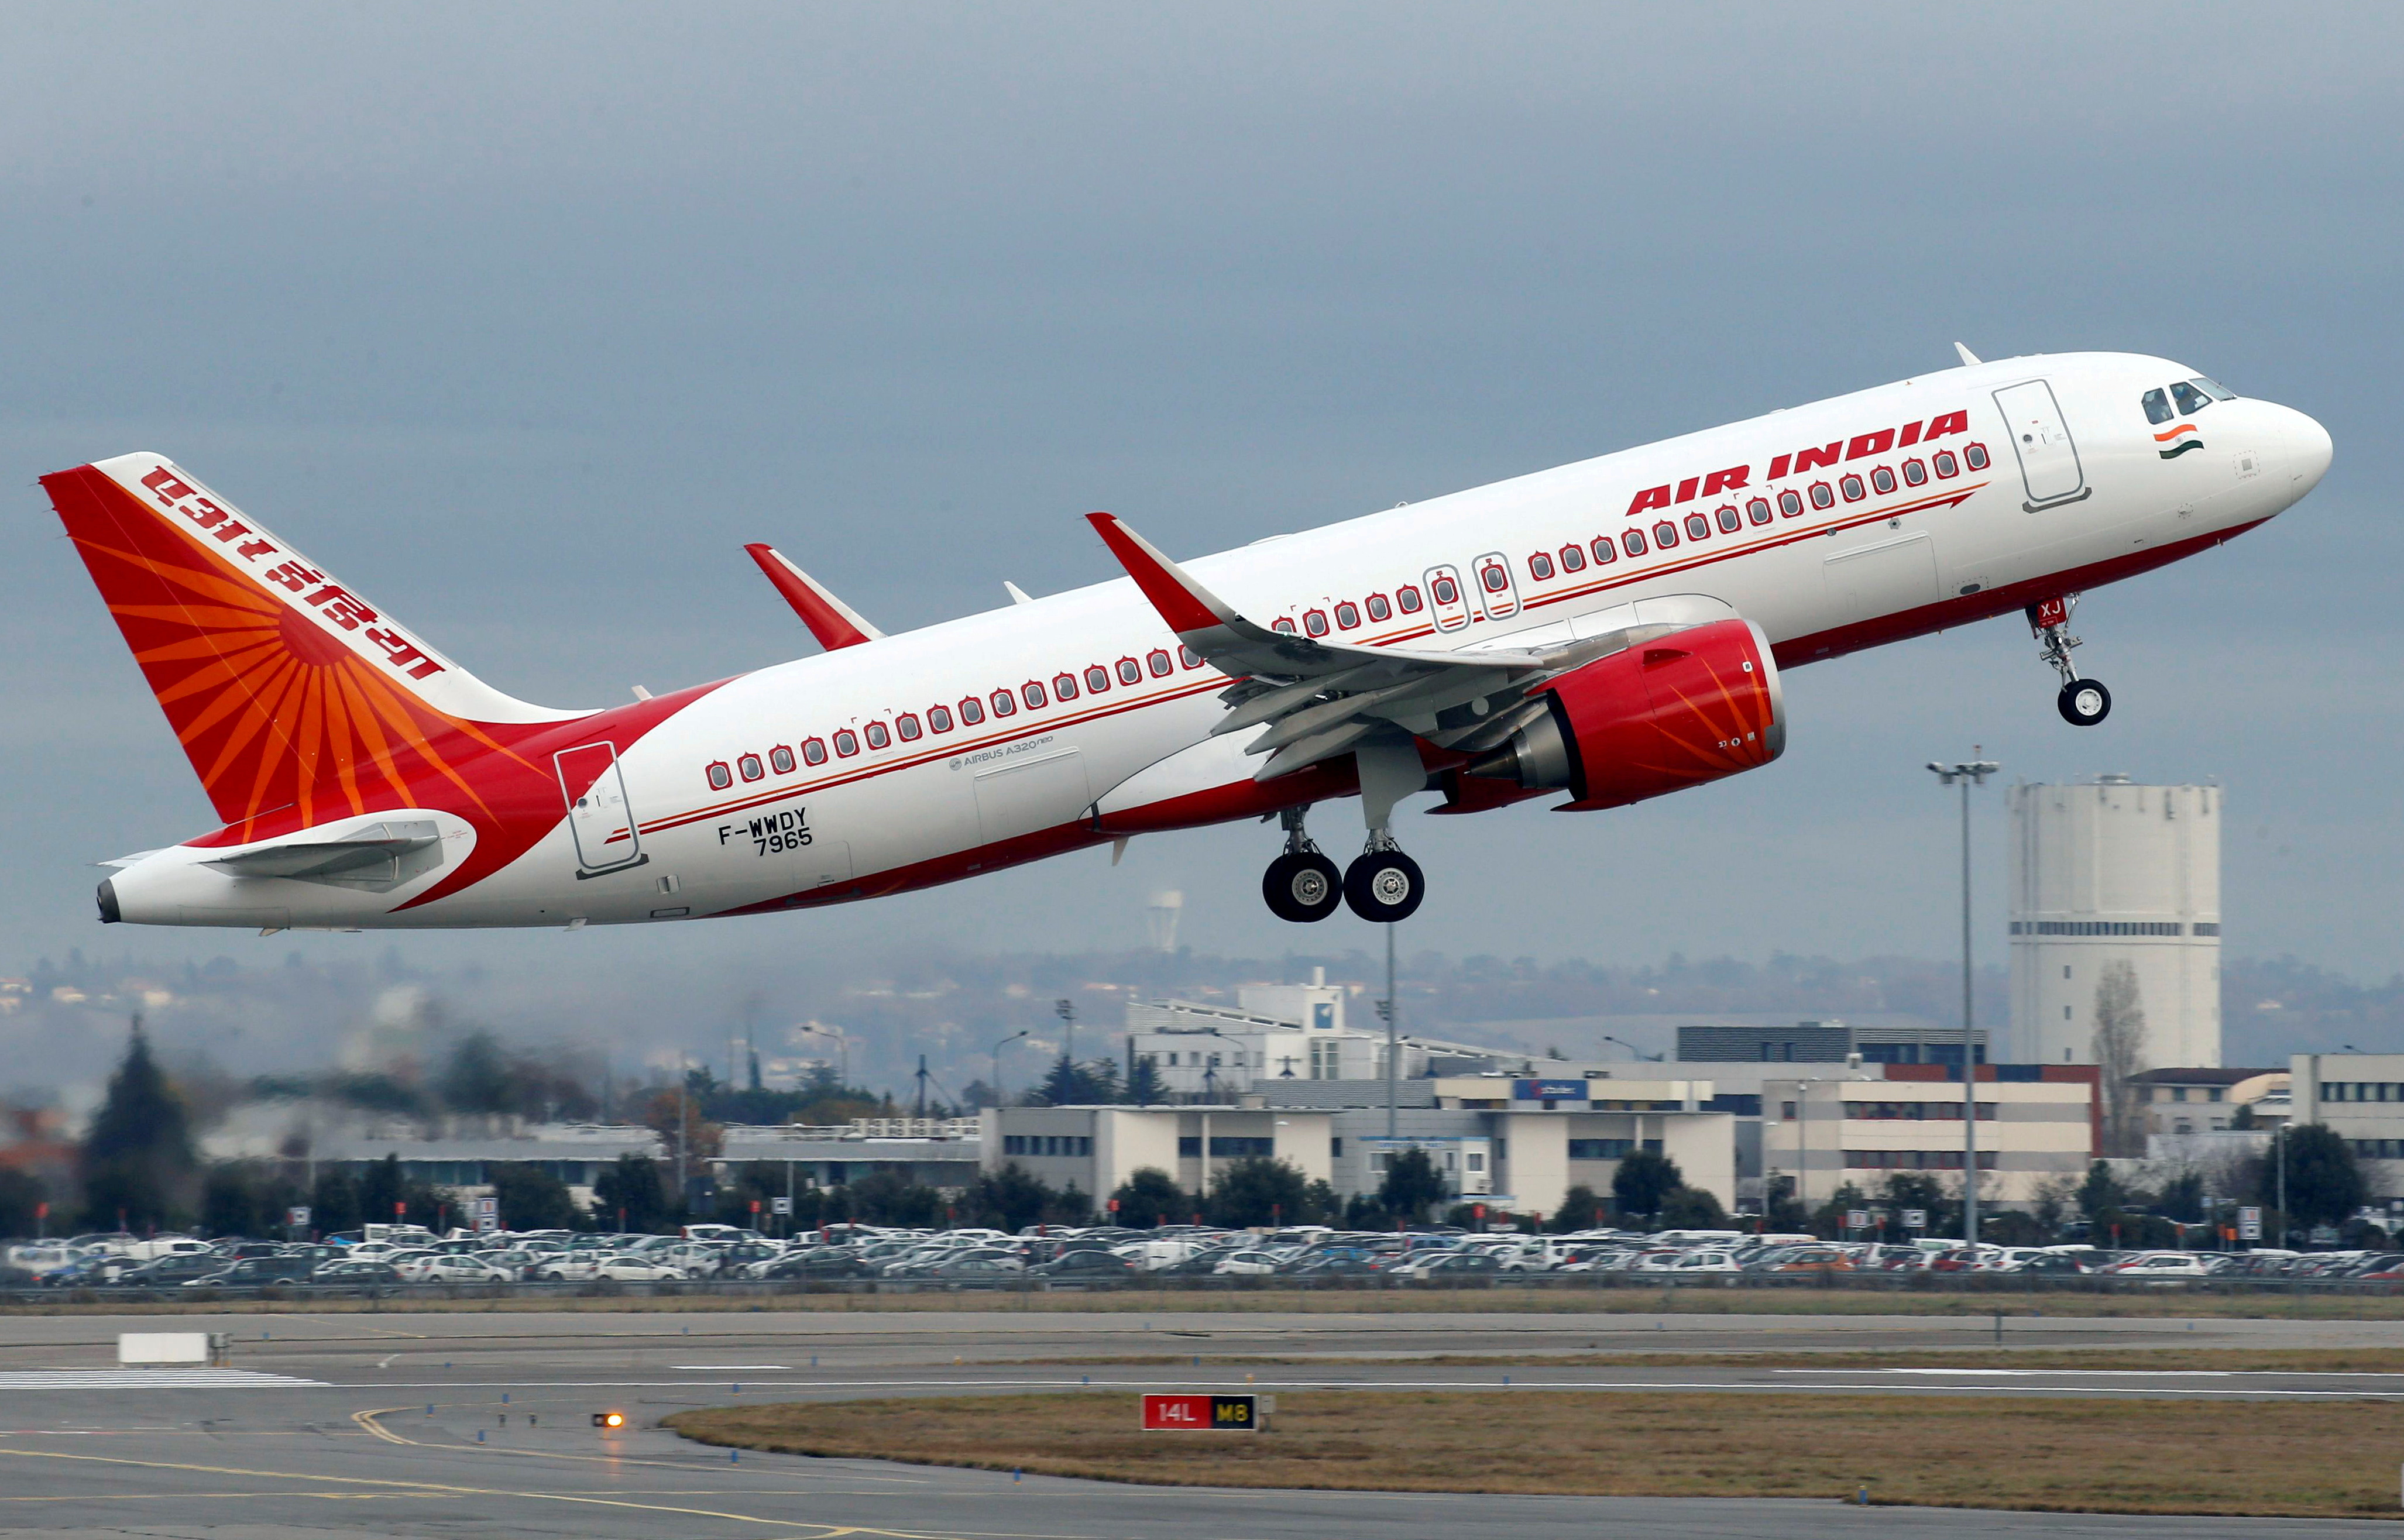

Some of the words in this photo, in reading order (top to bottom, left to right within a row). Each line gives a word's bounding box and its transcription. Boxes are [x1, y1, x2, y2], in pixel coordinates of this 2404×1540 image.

[1626, 465, 1750, 517] AIR
[1767, 410, 1968, 481] INDIA
[140, 465, 279, 562] एअर
[265, 560, 447, 680] इंडिया
[2041, 600, 2060, 617] XJ
[964, 748, 1004, 766] AIRBUS
[718, 807, 806, 845] F-WWDY
[753, 826, 813, 857] 7965
[1158, 1403, 1196, 1422] 14L
[1216, 1404, 1248, 1422] M8
